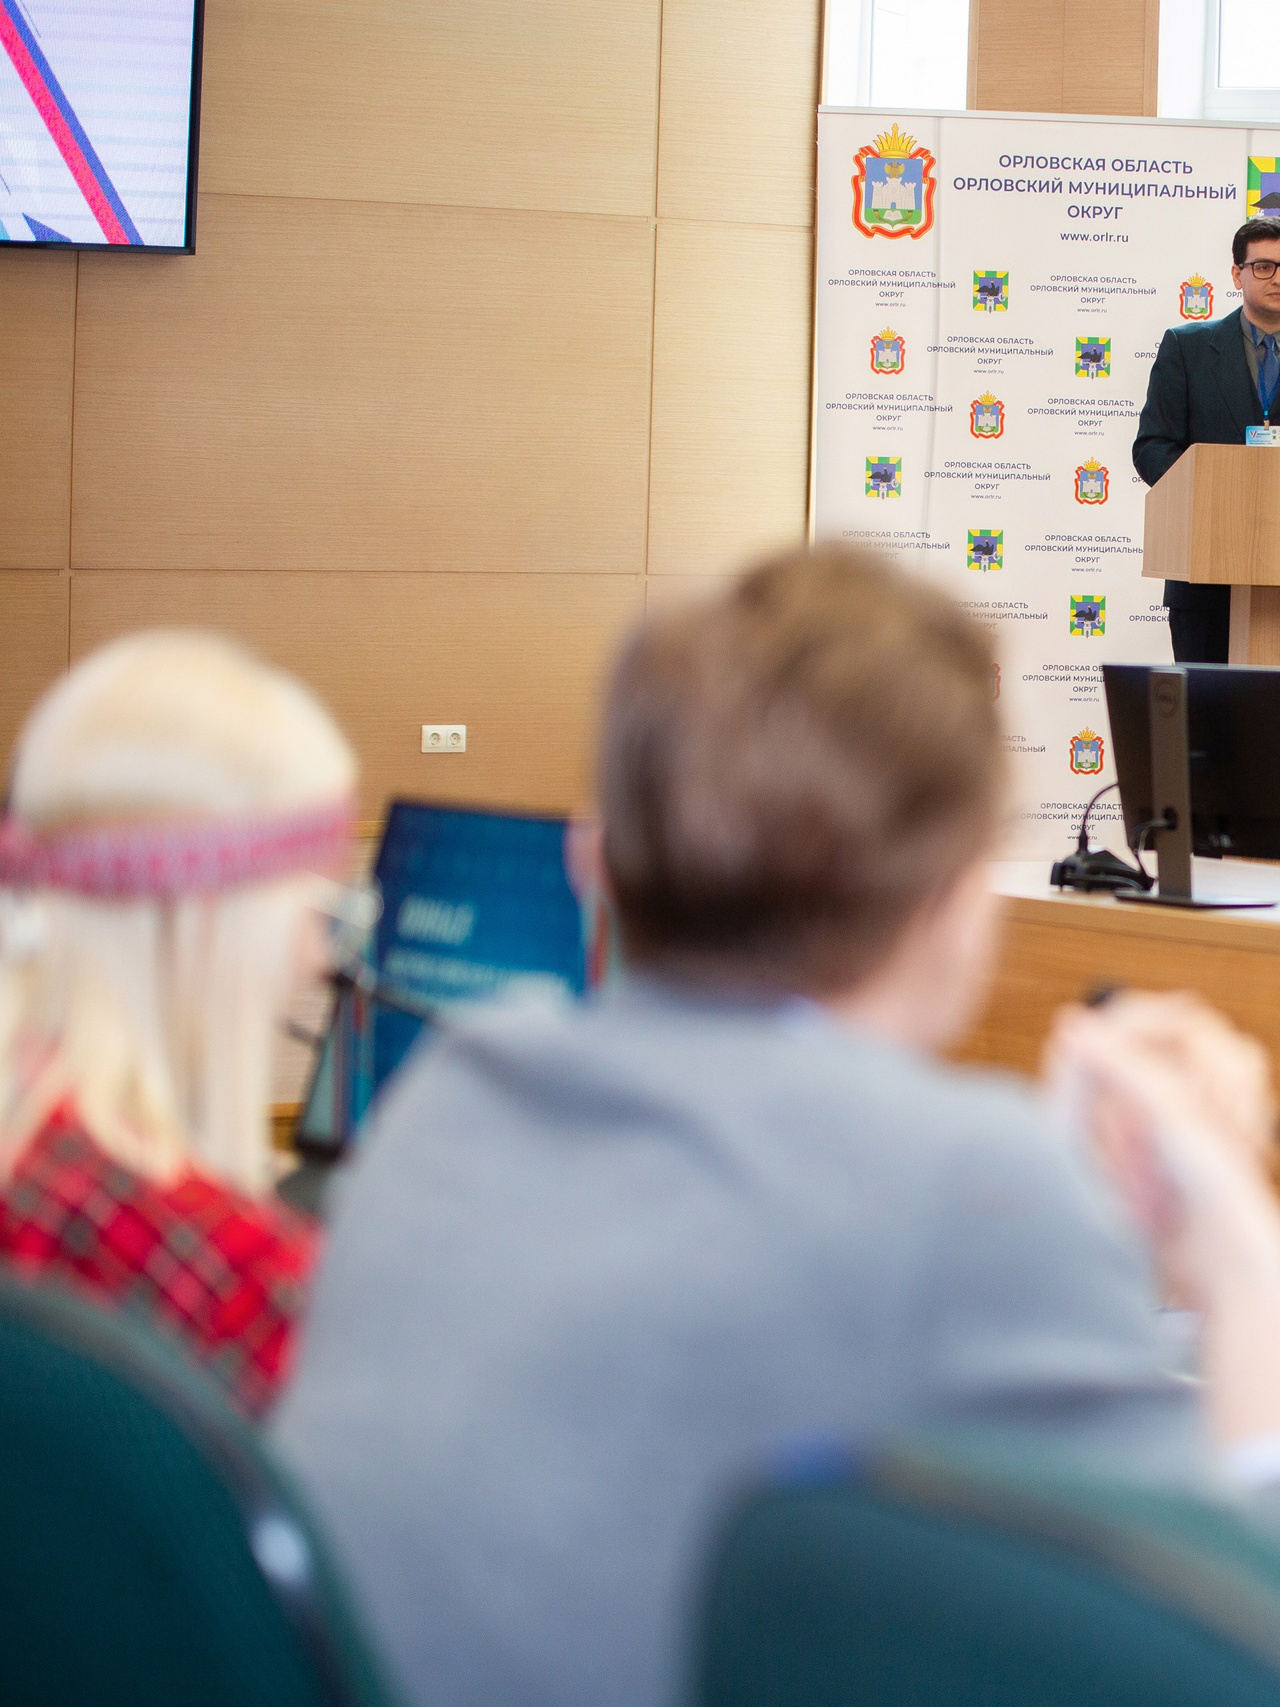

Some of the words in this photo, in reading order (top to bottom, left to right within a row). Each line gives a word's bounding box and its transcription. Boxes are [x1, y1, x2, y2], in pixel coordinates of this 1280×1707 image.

[999, 155, 1106, 171] ОРЛОВСКАЯ
[1111, 158, 1193, 174] ОБЛАСТЬ
[953, 177, 1063, 194] ОРЛОВСКИЙ
[1068, 181, 1237, 200] МУНИЦИПАЛЬНЫЙ
[1067, 205, 1123, 220] ОКРУГ
[1060, 231, 1129, 243] www.orlr.ru
[848, 269, 897, 278] ОРЛОВСКАЯ
[898, 270, 937, 278] ОБЛАСТЬ
[828, 278, 878, 287] ОРЛОВСКИЙ
[879, 280, 956, 290] МУНИЦИПАЛЬНЫЙ
[1050, 275, 1098, 283] ОРЛОВСКАЯ
[1100, 276, 1137, 284] ОБЛАСТЬ
[1030, 284, 1079, 293] ОРЛОВСКИЙ
[1081, 286, 1157, 296] МУНИЦИПАЛЬНЫЙ
[947, 336, 995, 344] ОРЛОВСКАЯ
[997, 337, 1034, 345] ОБЛАСТЬ
[926, 345, 976, 354] ОРЛОВСКИЙ
[978, 347, 1054, 356] МУНИЦИПАЛЬНЫЙ
[845, 392, 894, 401] ОРЛОВСКАЯ
[1047, 398, 1096, 406] ОРЛОВСКАЯ
[1097, 399, 1135, 407] ОБЛАСТЬ
[825, 402, 875, 411] ОРЛОВСКИЙ
[877, 404, 953, 413] МУНИЦИПАЛЬНЫЙ
[1027, 407, 1077, 416] ОРЛОВСКИЙ
[1078, 409, 1141, 418] МУНИЦИПАЛЬН
[944, 461, 992, 469] ОРЛОВСКАЯ
[994, 462, 1031, 470] ОБЛАСТЬ
[924, 471, 973, 479] ОРЛОВСКИЙ
[975, 473, 1051, 481] МУНИЦИПАЛЬНЫЙ
[842, 530, 891, 539] ОРЛОВСКАЯ
[893, 531, 931, 539] ОБЛАСТЬ
[1045, 534, 1093, 543] ОРЛОВСКАЯ
[1094, 536, 1132, 544] ОБЛАСТЬ
[873, 541, 951, 551] МУНИЦИПАЛЬНЫЙ
[1025, 544, 1074, 553] ОРЛОВСКИЙ
[972, 612, 1048, 620] МУНИЦИПАЛЬНЫЙ
[1129, 614, 1170, 622] ОРЛОВСК
[1042, 664, 1090, 672] ОРЛОВСКАЯ
[1022, 674, 1071, 682] ОРЛОВСКИЙ
[1040, 802, 1088, 810] ОРЛОВСКАЯ
[1020, 812, 1069, 820] ОРЛОВСКИЙ
